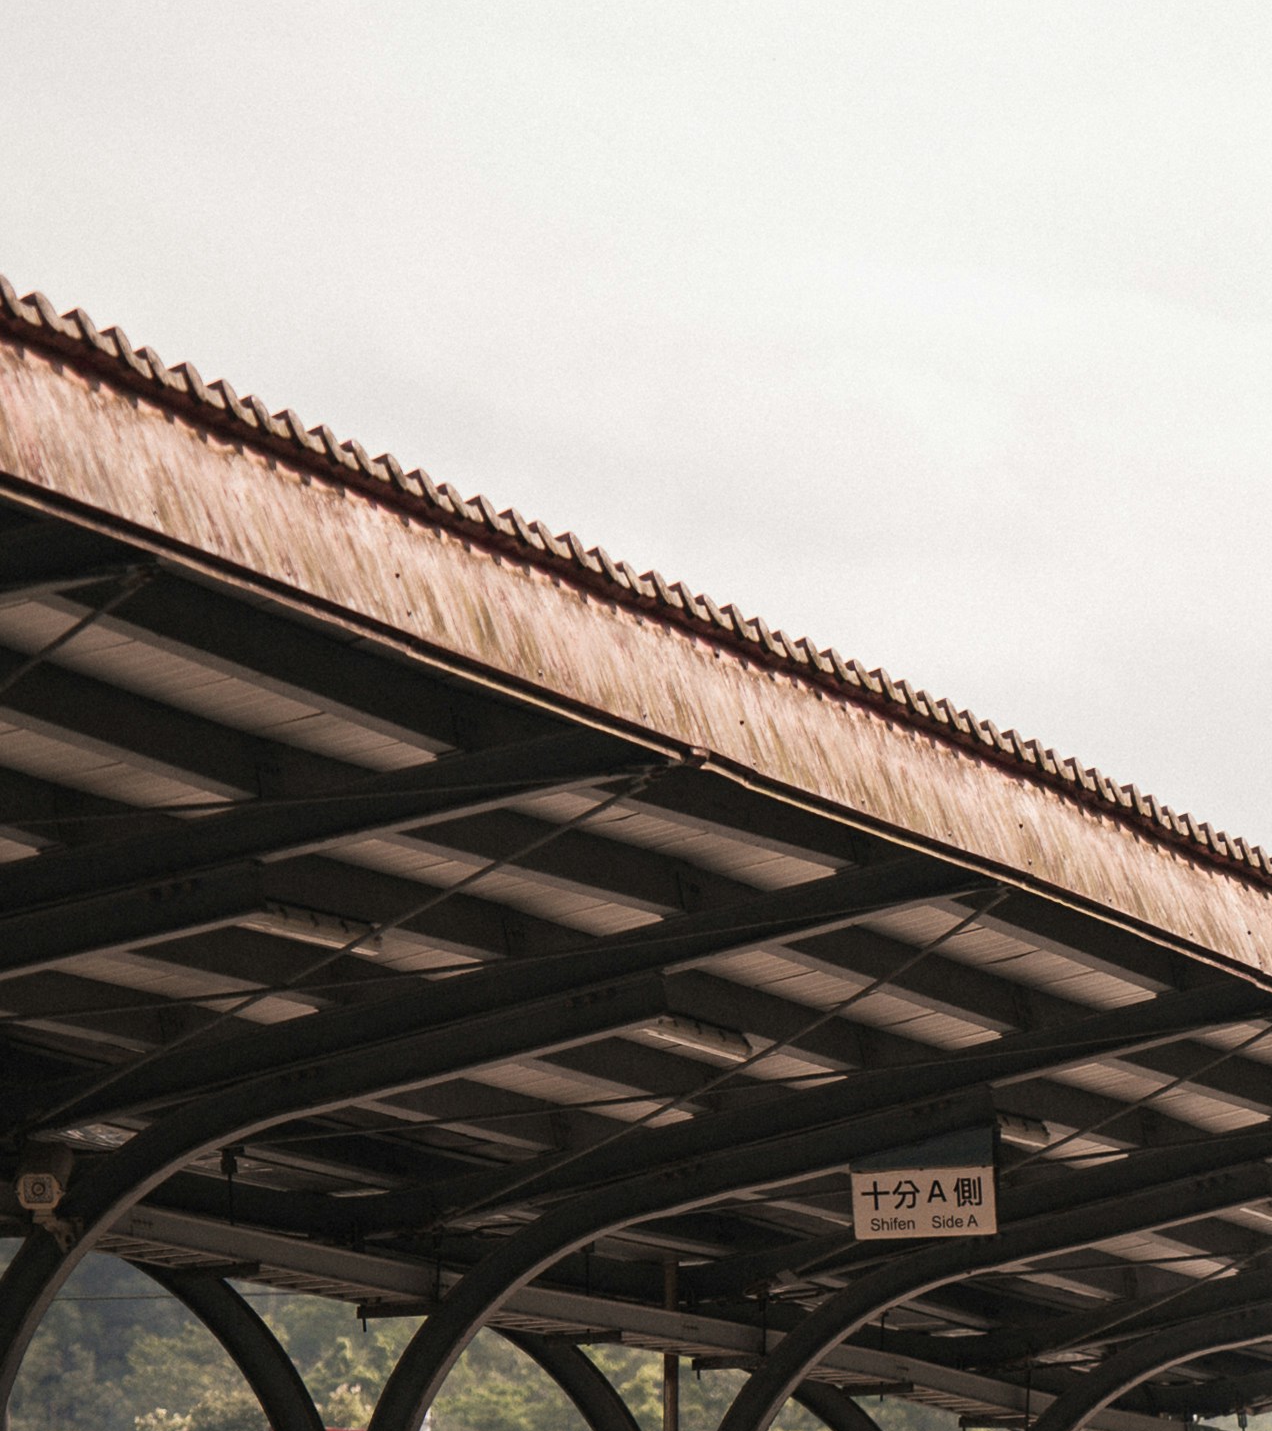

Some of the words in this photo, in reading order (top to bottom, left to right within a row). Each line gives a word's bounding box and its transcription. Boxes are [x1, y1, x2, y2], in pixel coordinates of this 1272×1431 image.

[870, 1217, 916, 1232] Shifen
[931, 1215, 964, 1229] Side
[967, 1214, 979, 1228] A
